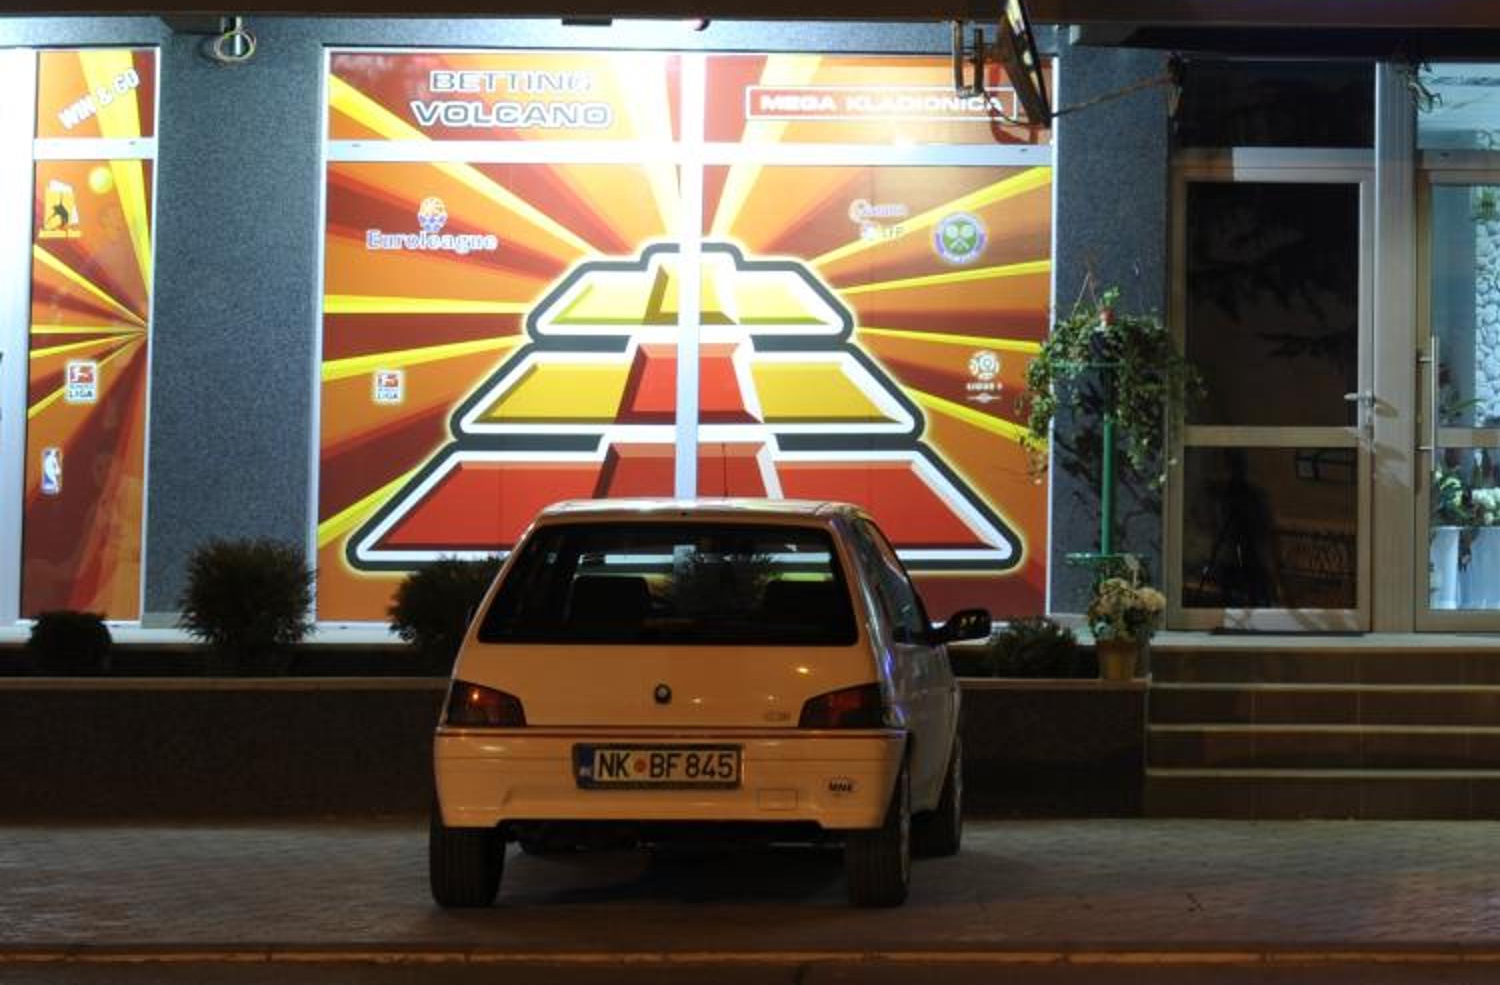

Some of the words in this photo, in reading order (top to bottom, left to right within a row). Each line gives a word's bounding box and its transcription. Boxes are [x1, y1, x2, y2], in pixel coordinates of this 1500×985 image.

[431, 70, 594, 92] BETTING
[58, 94, 97, 129] WIN
[412, 102, 611, 127] VOLCANO
[760, 95, 836, 111] MEGA
[846, 96, 1004, 112] KLADIONICA
[367, 231, 497, 254] Euroleague
[599, 752, 630, 778] NK
[648, 752, 682, 778] BF
[685, 753, 734, 779] 845
